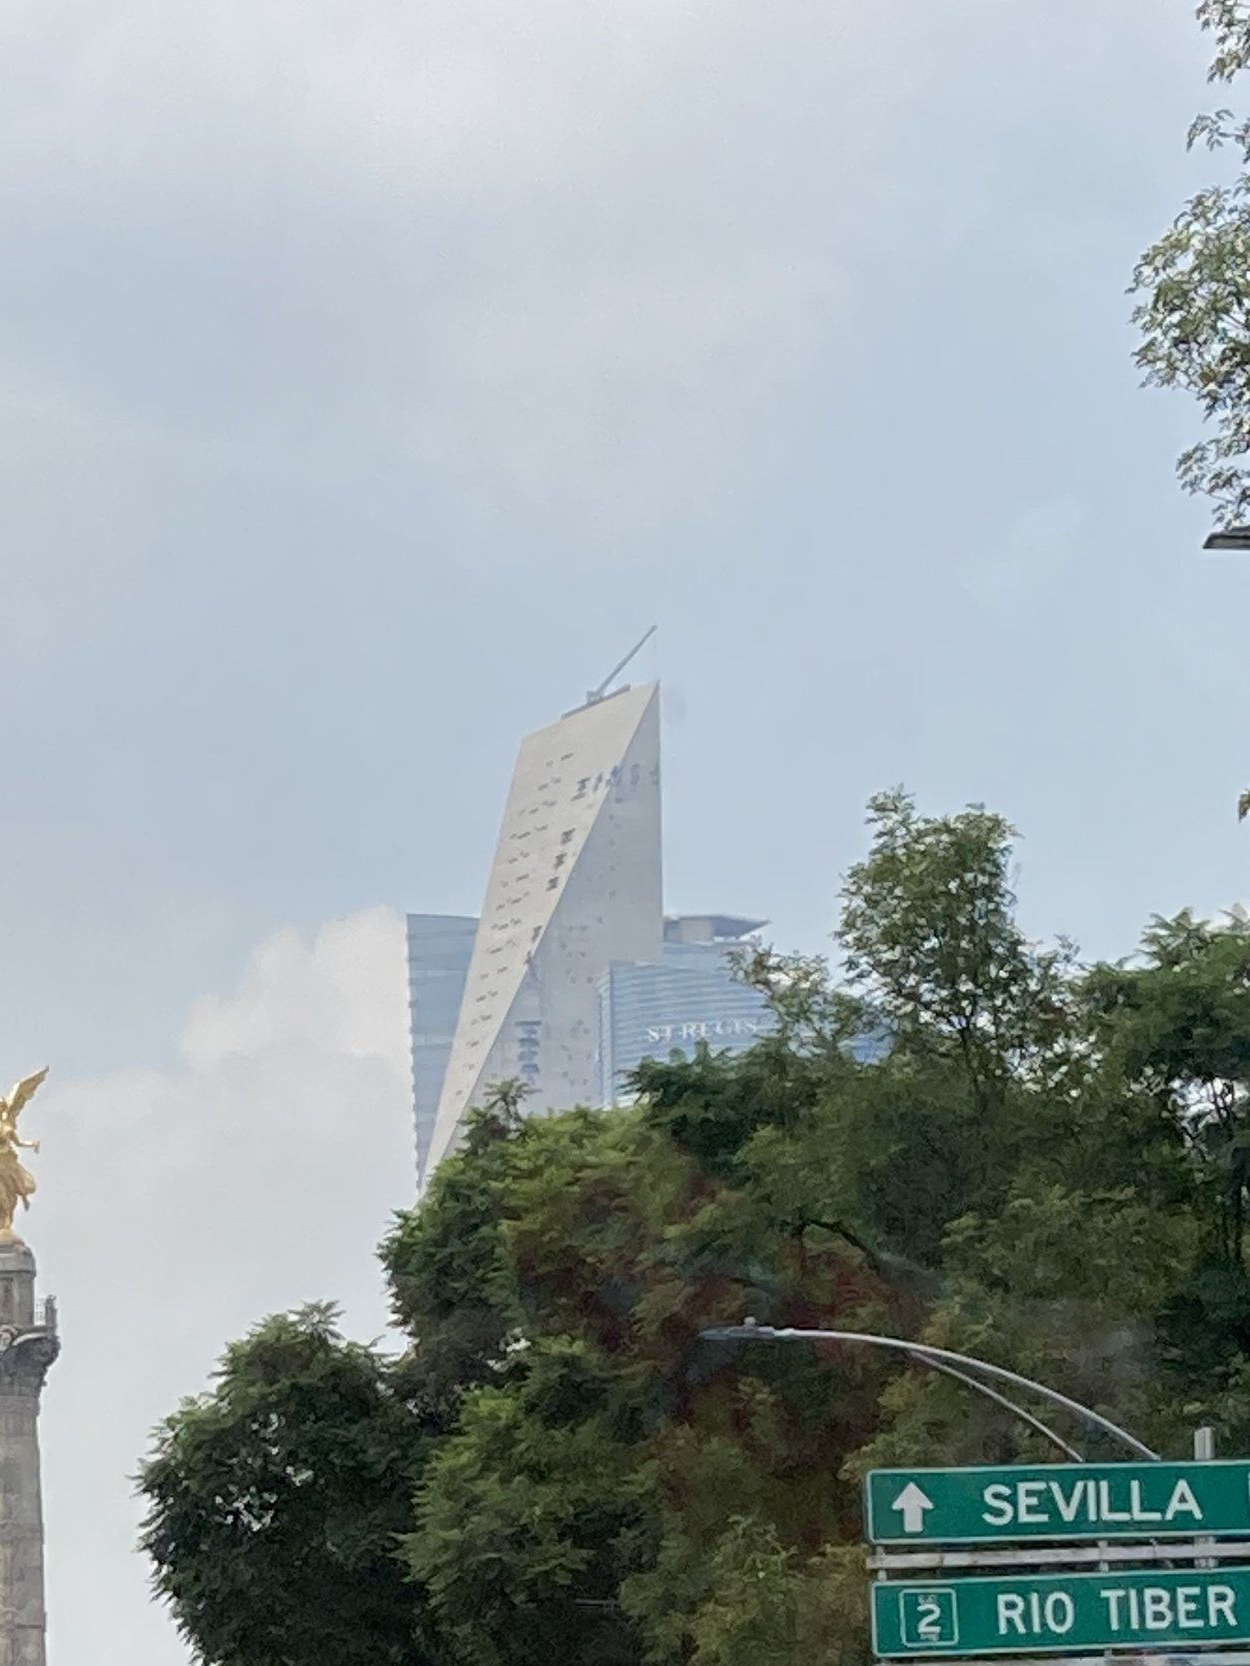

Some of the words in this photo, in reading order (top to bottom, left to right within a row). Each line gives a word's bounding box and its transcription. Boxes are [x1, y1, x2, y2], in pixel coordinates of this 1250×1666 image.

[981, 1477, 1204, 1526] SEVILLA
[916, 1603, 942, 1633] 2
[996, 1590, 1075, 1635] RIO
[1100, 1584, 1239, 1632] TIBER
